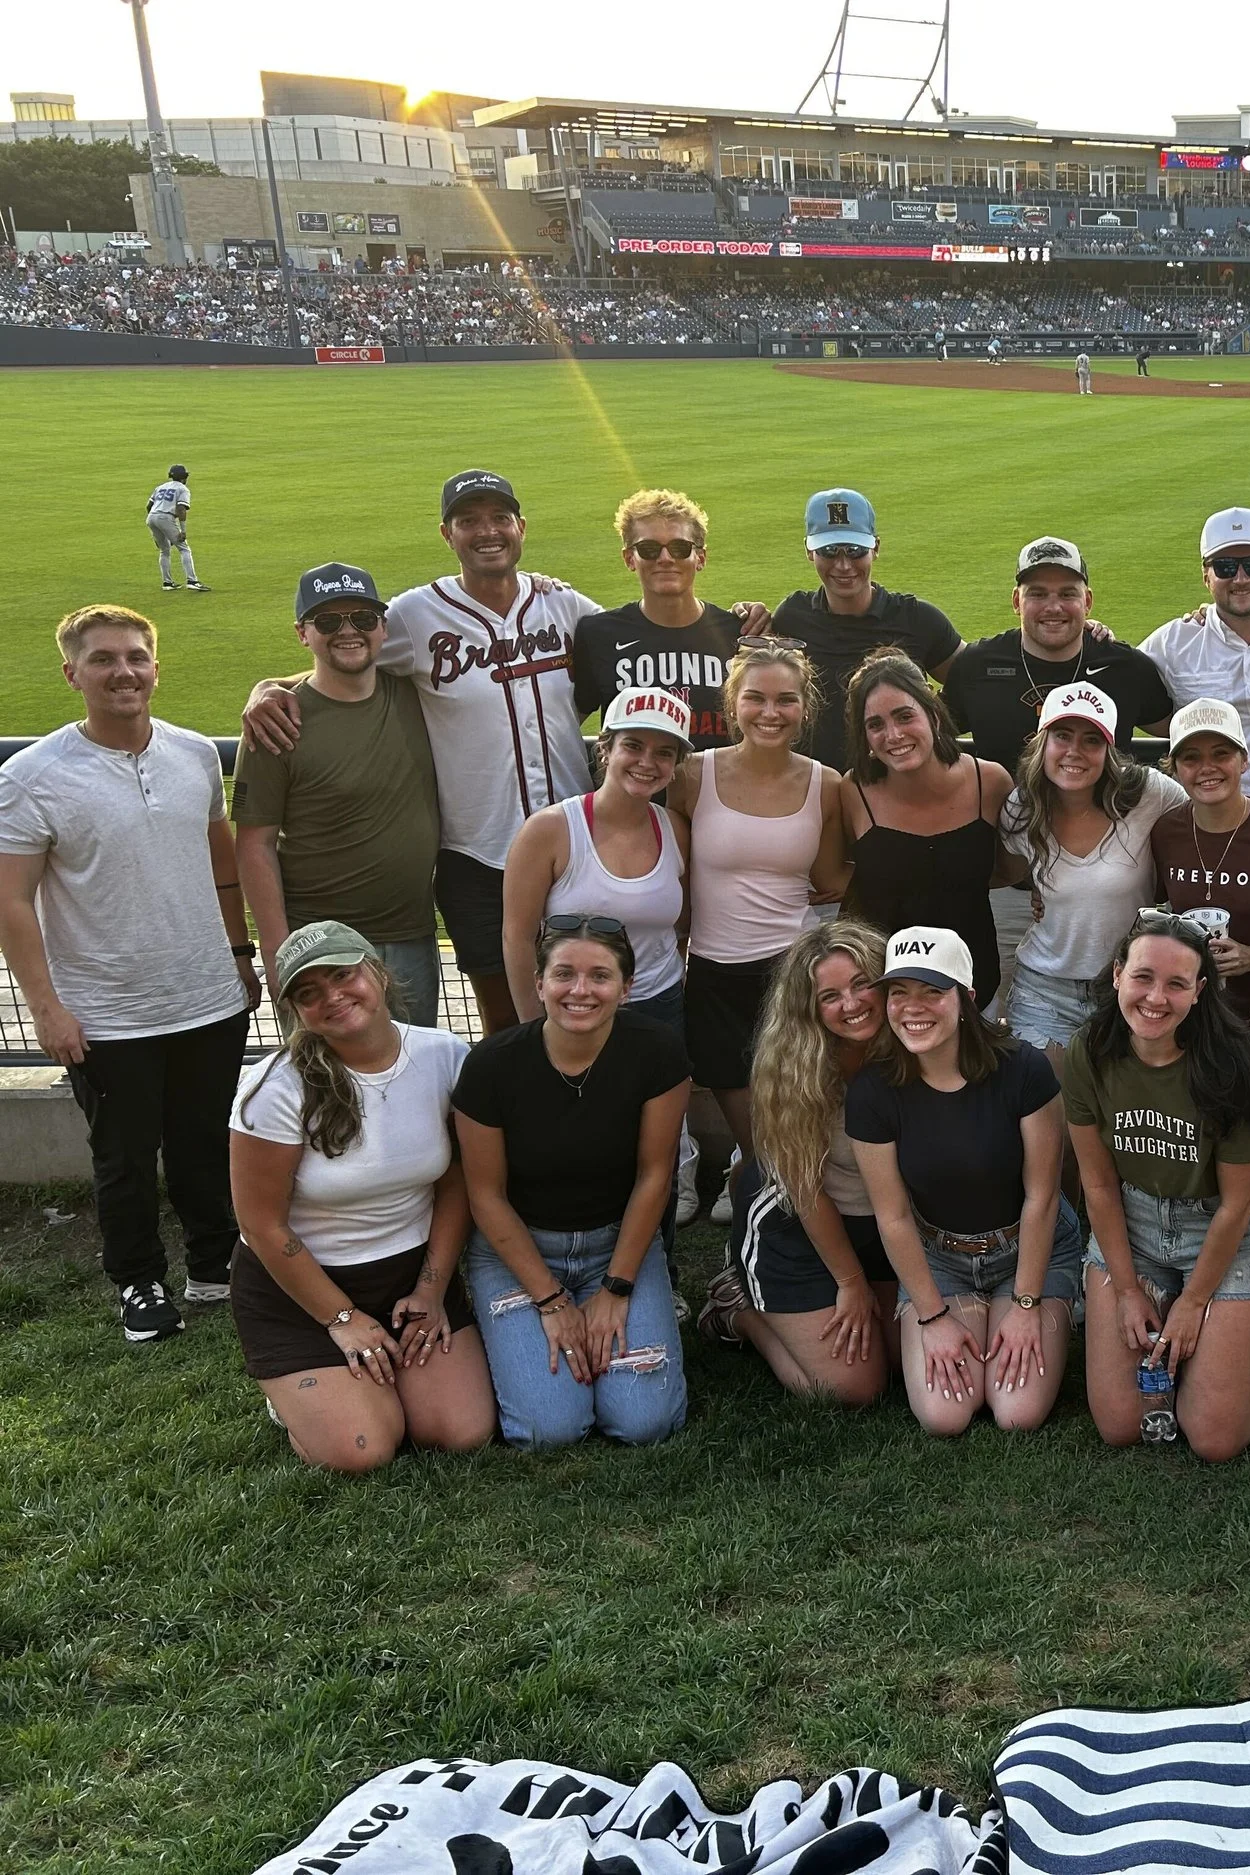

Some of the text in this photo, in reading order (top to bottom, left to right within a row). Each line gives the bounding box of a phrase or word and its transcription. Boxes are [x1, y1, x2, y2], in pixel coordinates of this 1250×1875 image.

[537, 227, 562, 236] MUSIC
[618, 238, 715, 254] PRE-ORDER
[716, 241, 773, 256] TODAY
[961, 245, 984, 253] BULLS
[330, 351, 358, 359] CIRCLE
[429, 629, 562, 691] Braves
[1060, 693, 1076, 708] UP
[1077, 690, 1105, 714] GIDDY
[625, 694, 686, 731] CMA FEST
[298, 930, 328, 950] TAYLOR
[894, 941, 936, 957] WAY
[1114, 1108, 1195, 1140] FAVORITE
[1113, 1133, 1199, 1164] DAUGHTER
